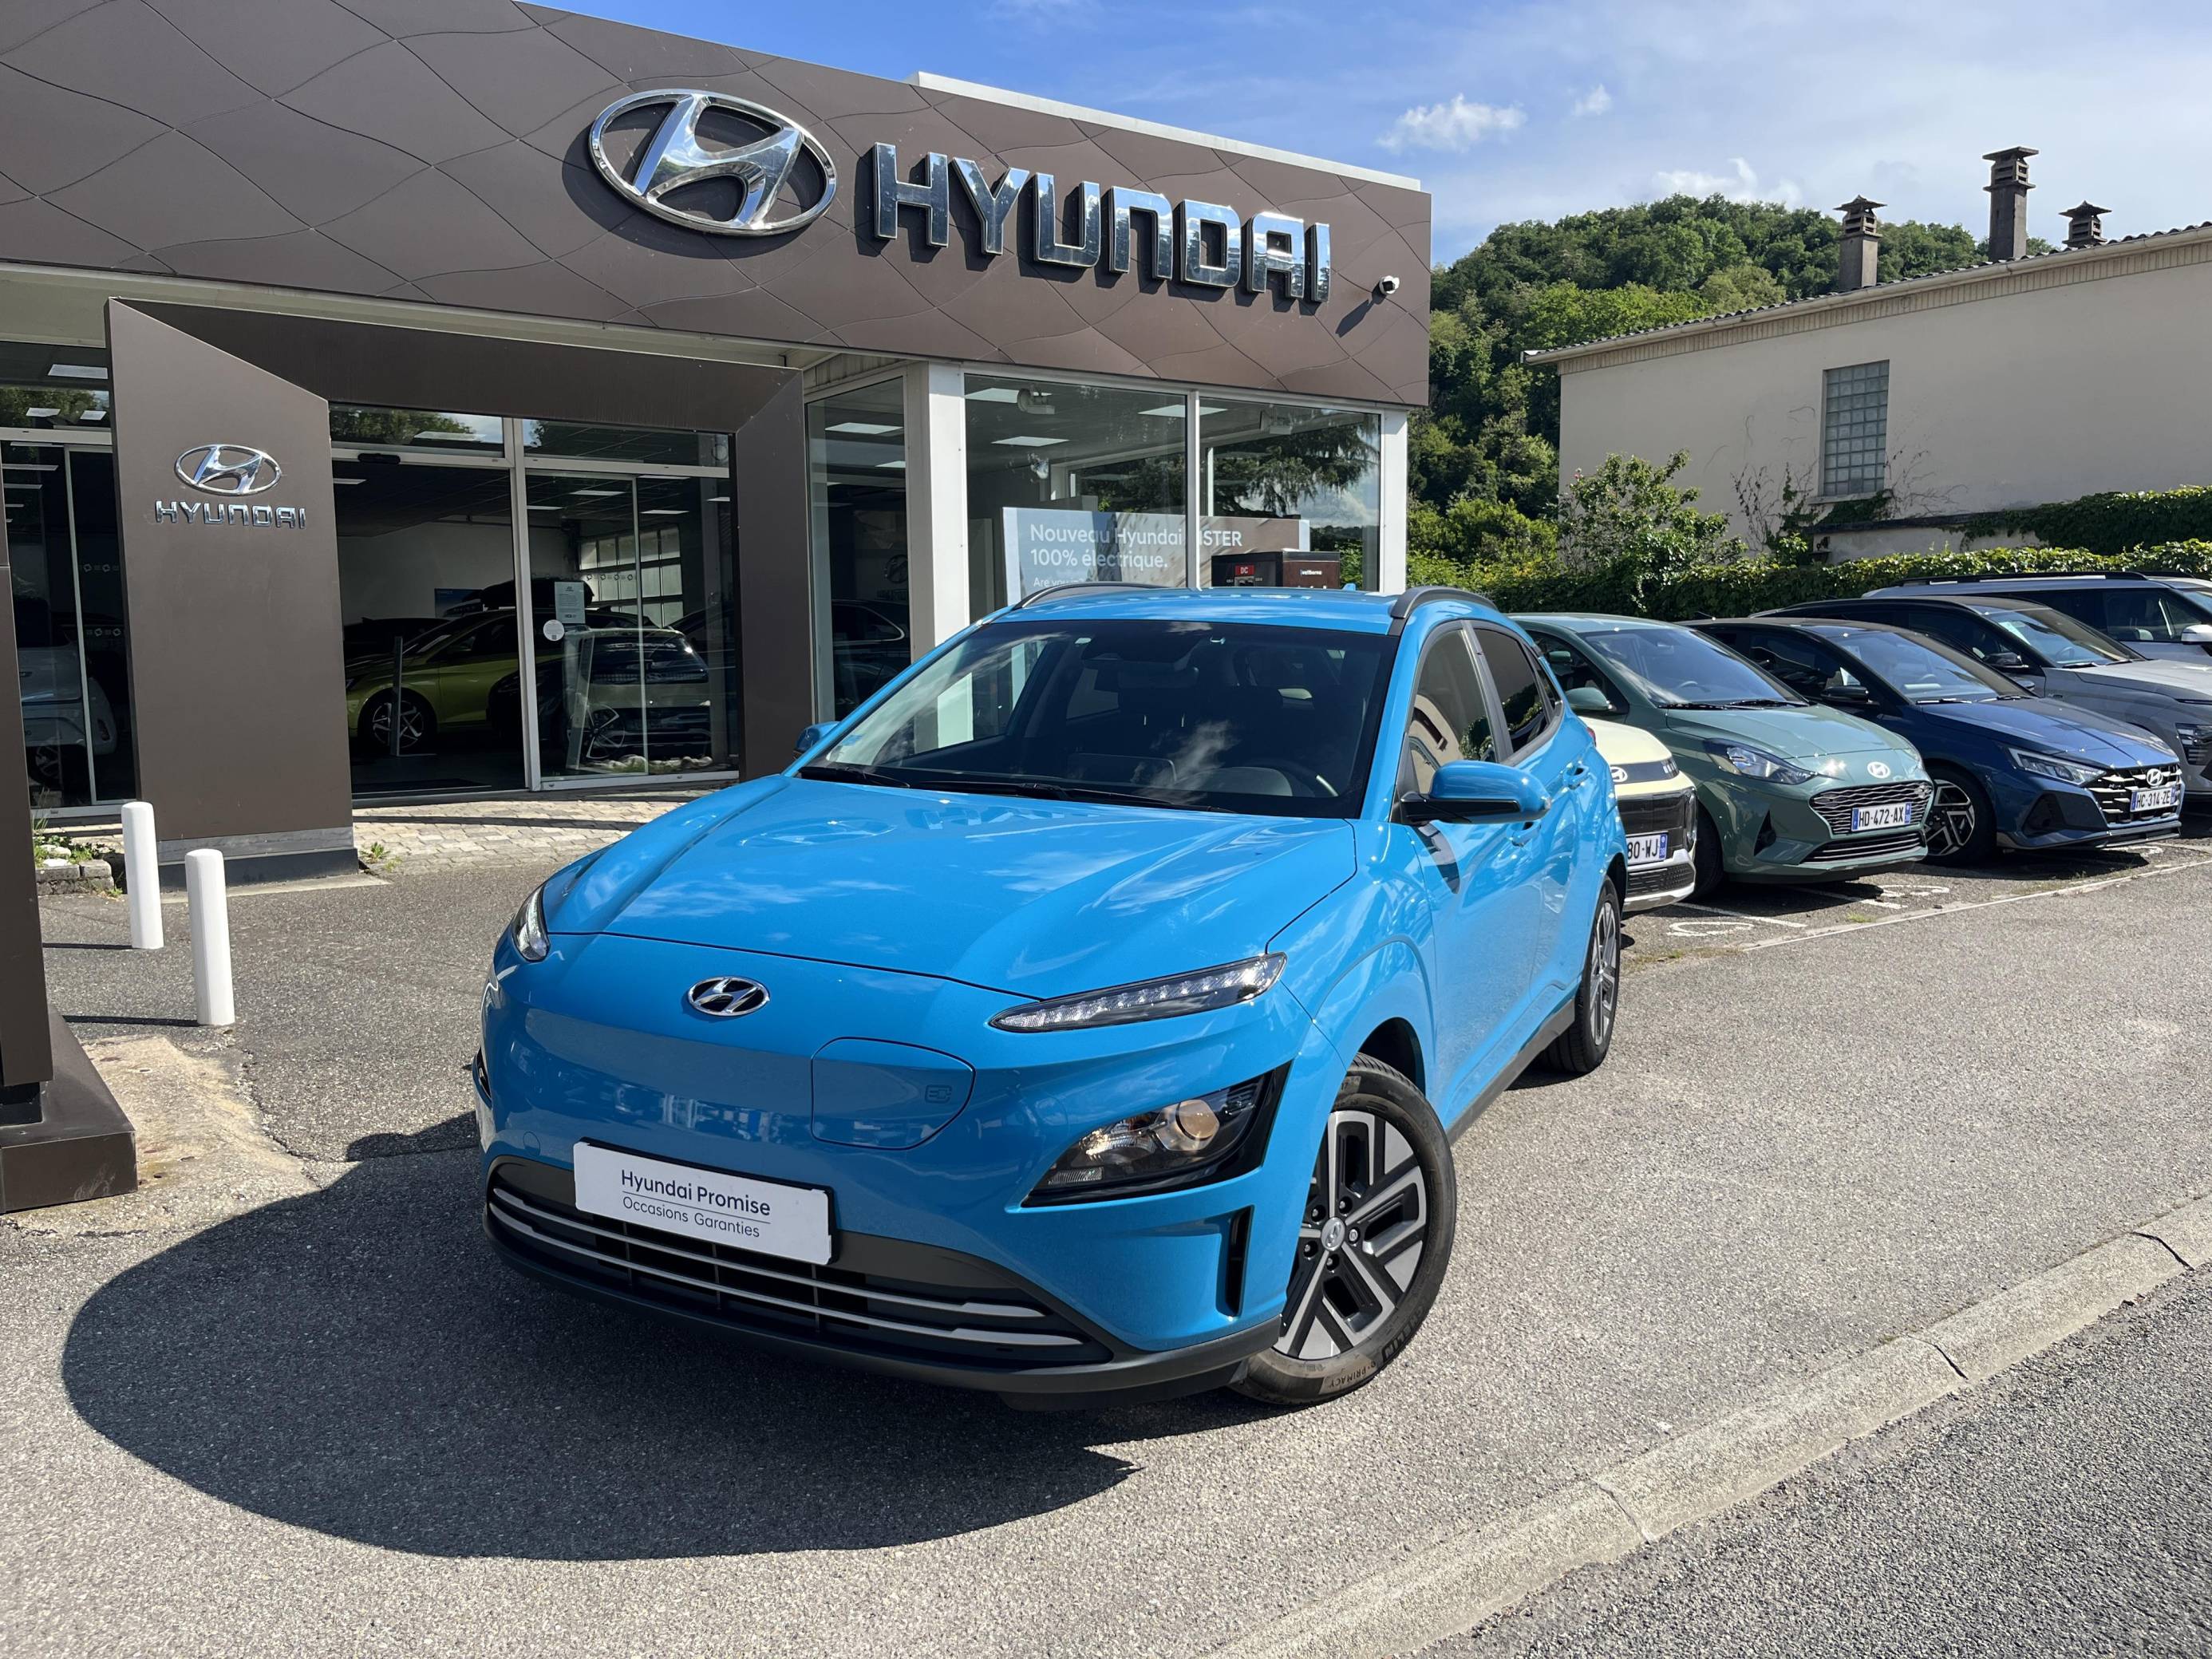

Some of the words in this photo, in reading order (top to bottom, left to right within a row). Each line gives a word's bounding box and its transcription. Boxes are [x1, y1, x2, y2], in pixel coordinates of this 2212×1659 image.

[874, 142, 1330, 302] HYUNDAI
[155, 500, 307, 530] HYUNDAI
[1030, 523, 1110, 543] Nouveau
[1116, 527, 1183, 547] Hyundai
[1030, 549, 1077, 566] 100%
[1082, 550, 1168, 571] électrique.
[1033, 577, 1049, 587] Are
[2137, 790, 2171, 808] HC-314-ZE
[1858, 807, 1904, 827] HD-472-AX
[622, 1170, 692, 1201] Hyundai
[697, 1186, 771, 1215] Promise
[622, 1196, 689, 1222] Occasions
[694, 1212, 760, 1238] Garanties
